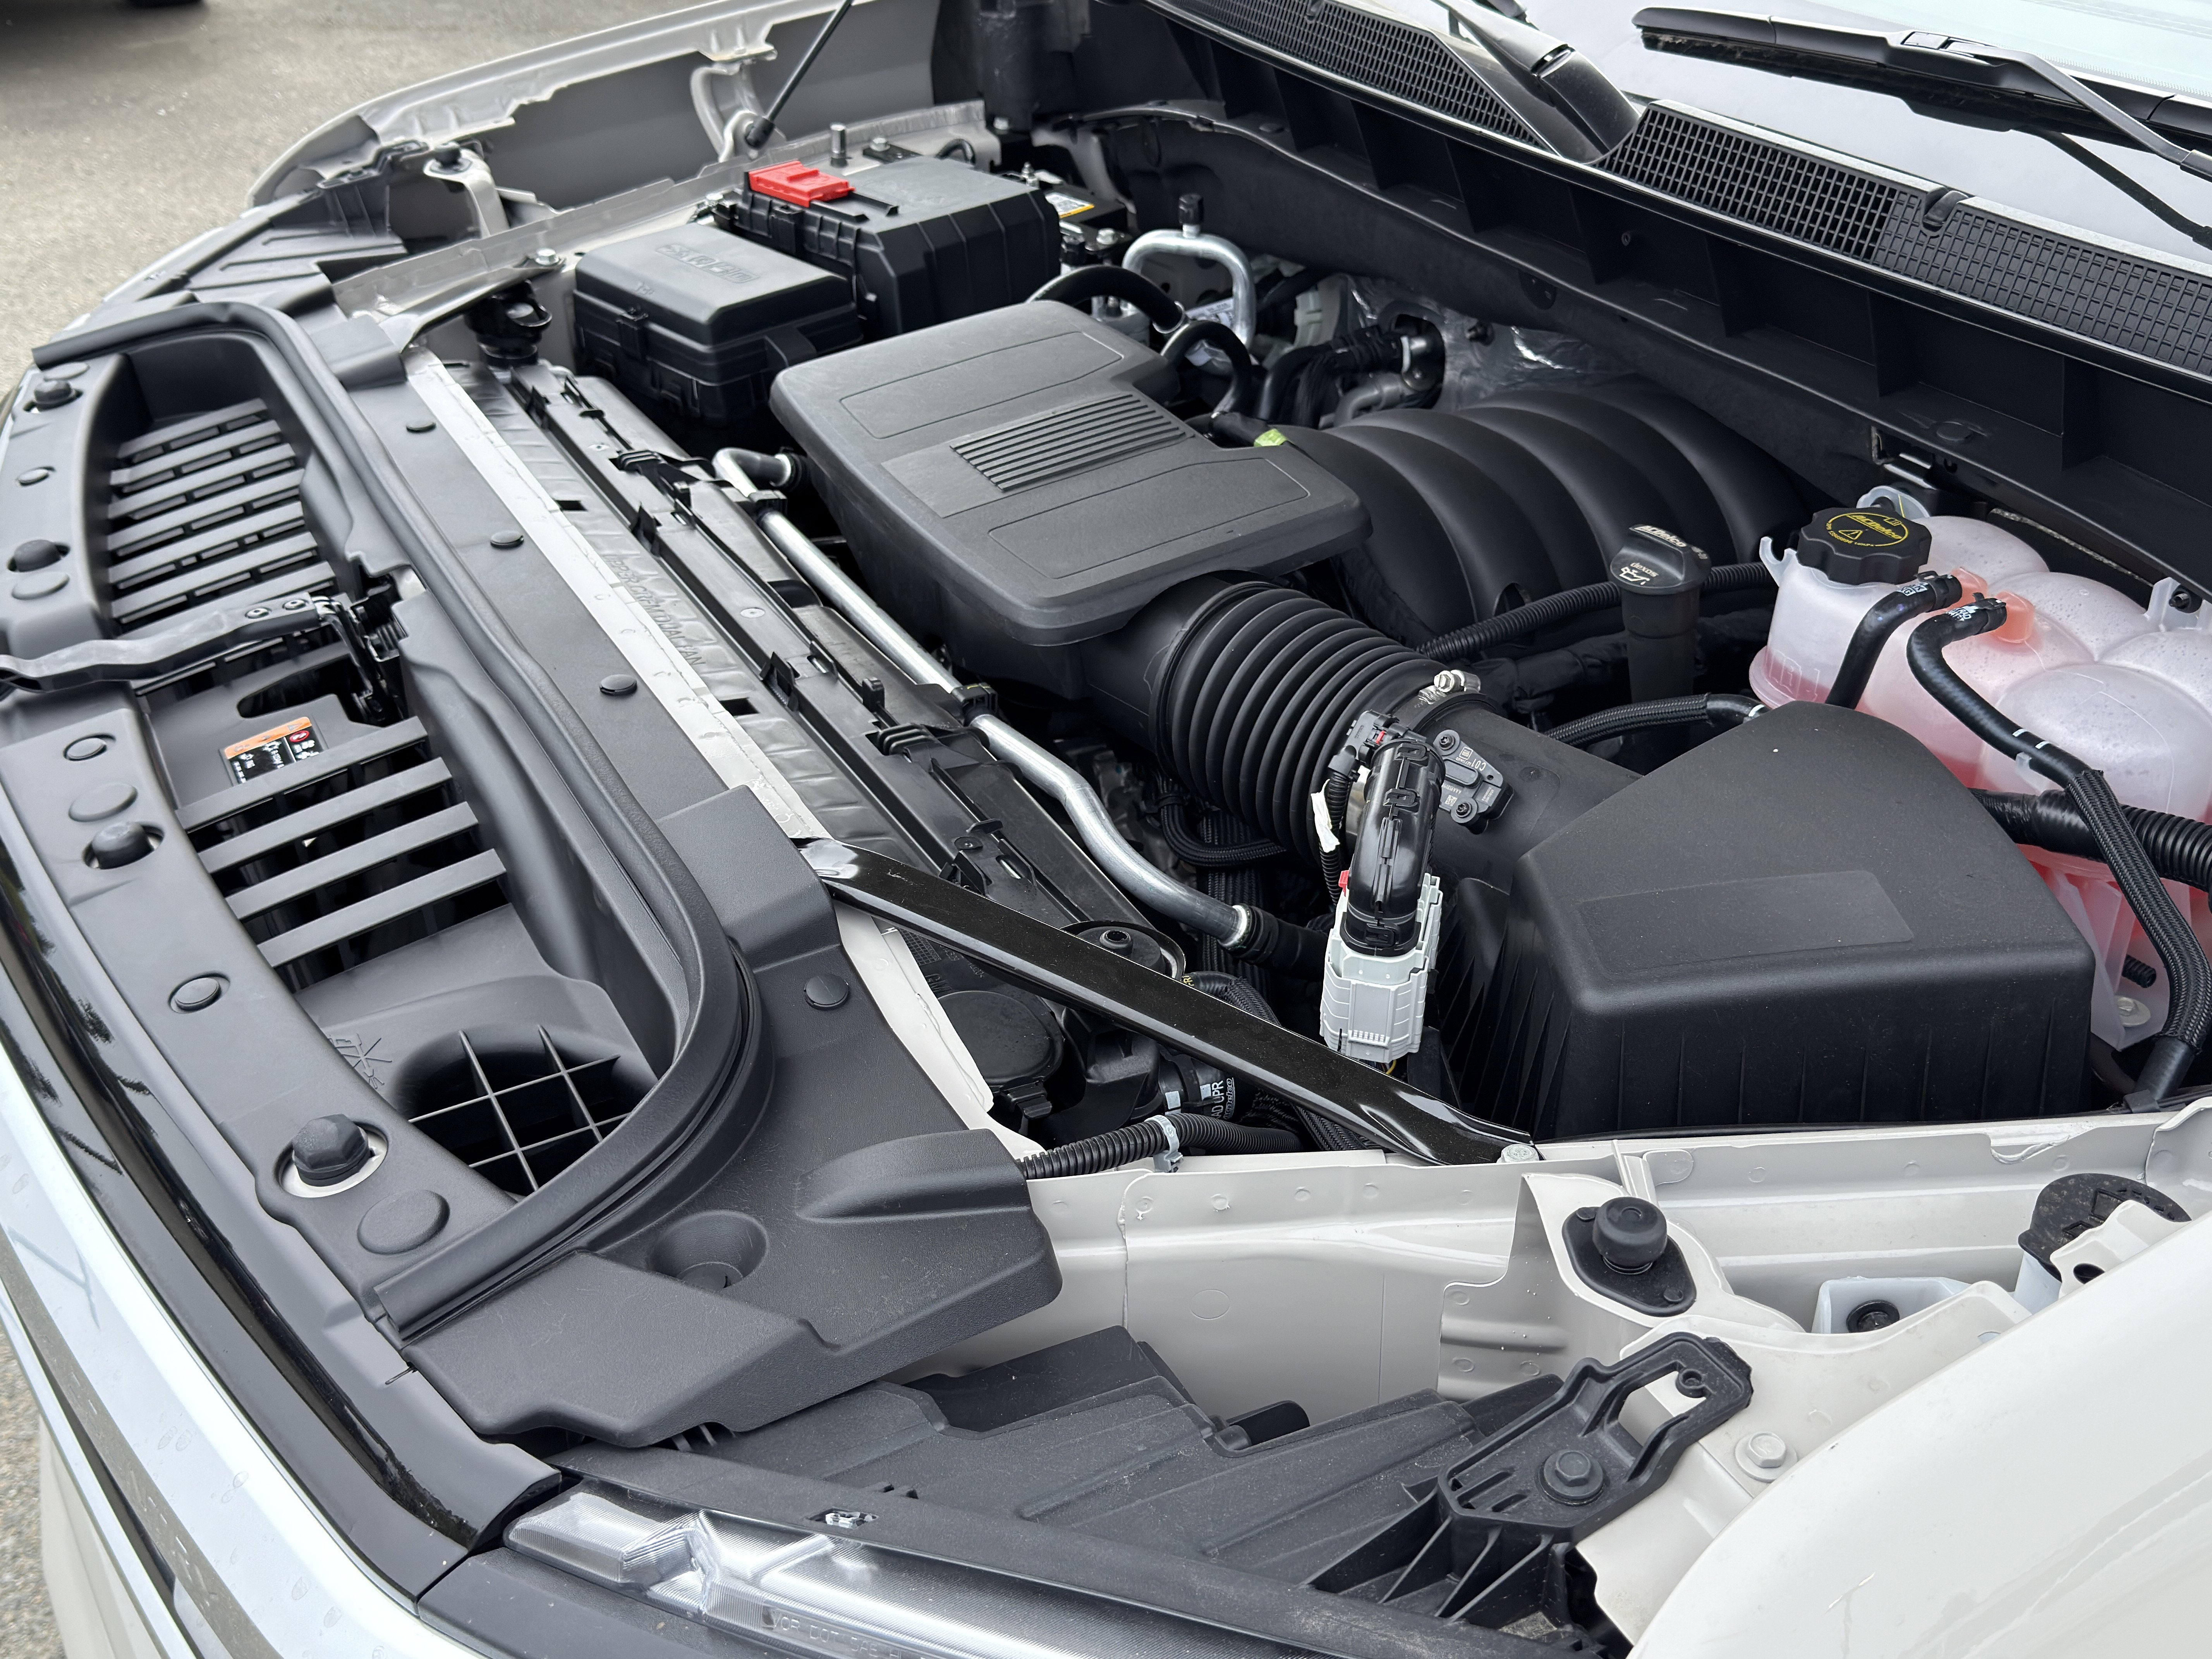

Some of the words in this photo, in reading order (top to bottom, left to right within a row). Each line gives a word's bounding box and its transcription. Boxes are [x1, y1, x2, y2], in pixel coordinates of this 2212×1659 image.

[1634, 525, 1687, 548] ACDelco
[1850, 515, 1903, 539] ACDelco
[1630, 562, 1659, 577] dexos
[676, 645, 706, 665] FAN
[809, 1625, 839, 1644] DOT
[850, 1637, 878, 1658] SAE
